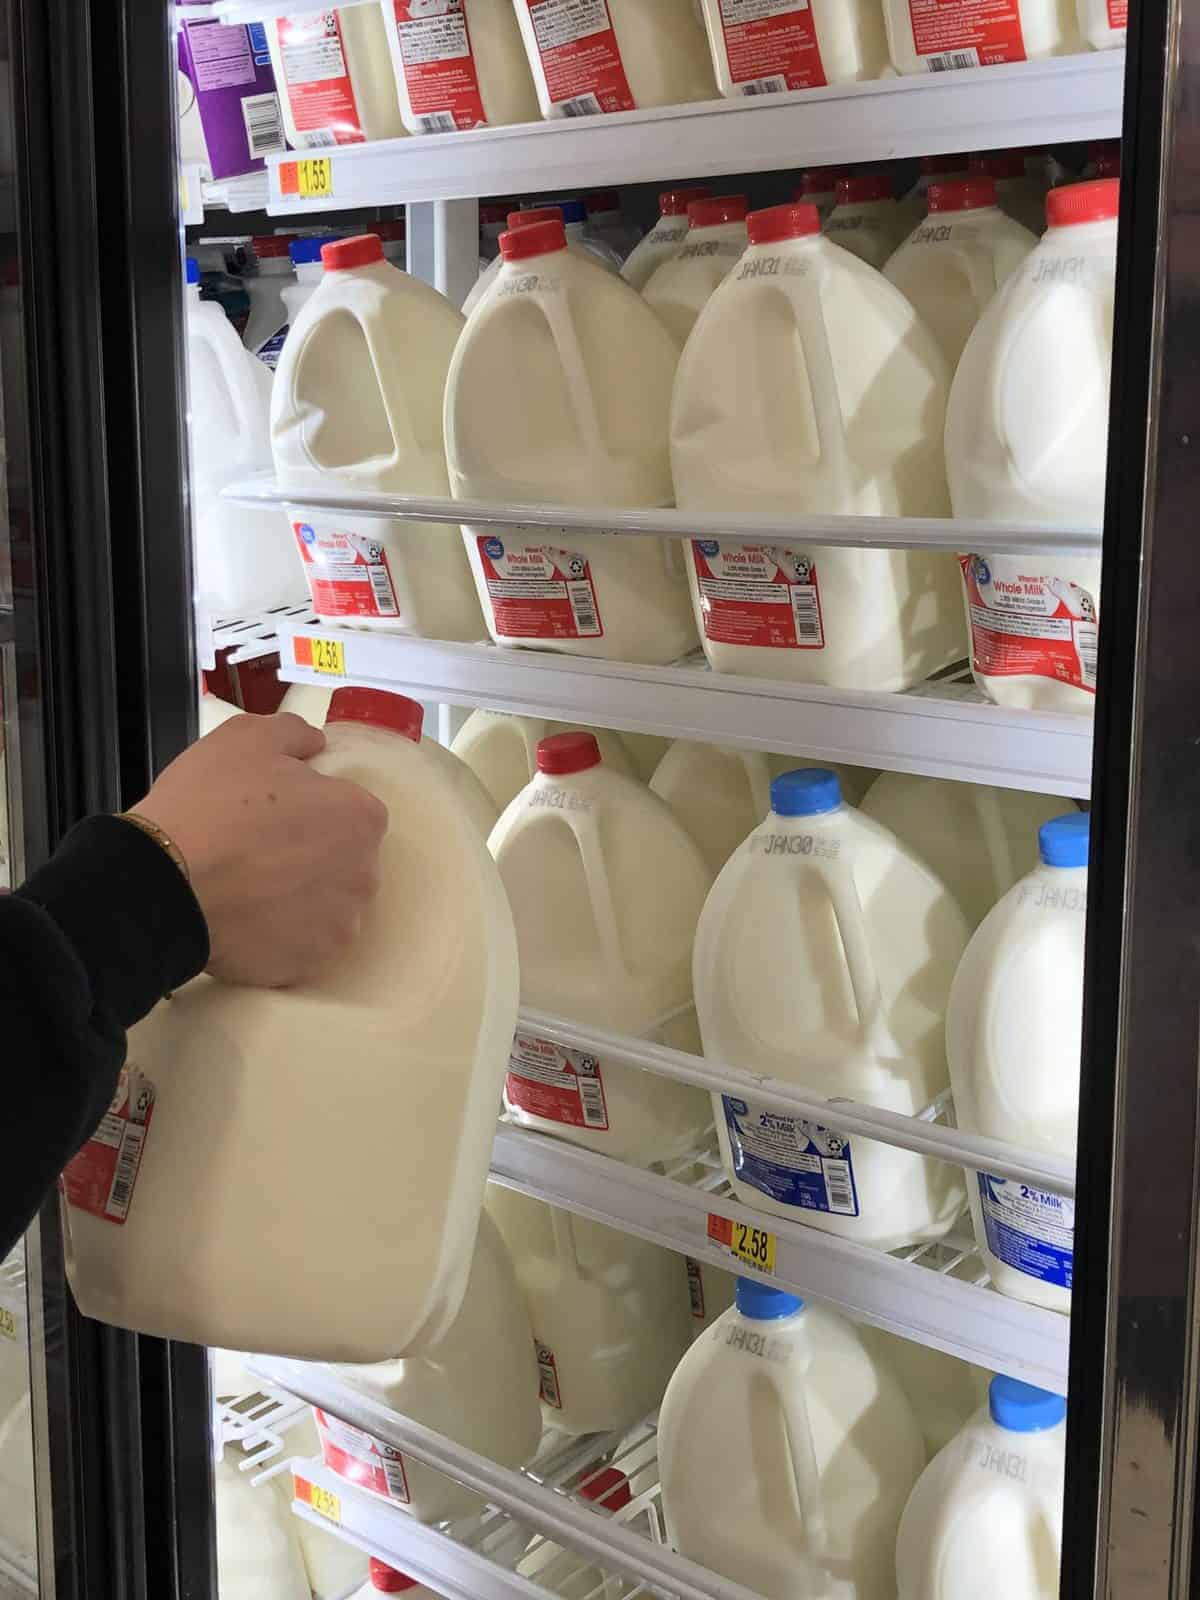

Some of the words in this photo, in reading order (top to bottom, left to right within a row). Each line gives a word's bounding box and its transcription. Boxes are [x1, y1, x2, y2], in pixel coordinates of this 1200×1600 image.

[304, 159, 327, 193] 1.55
[737, 256, 782, 281] JAN31
[993, 581, 1023, 594] Whole
[1024, 583, 1045, 595] Milk
[763, 834, 814, 856] JAN30
[1020, 1185, 1039, 1202] 2%
[1039, 1194, 1063, 1209] Milk
[738, 1224, 768, 1262] 2.58
[726, 1325, 767, 1357] JAN31
